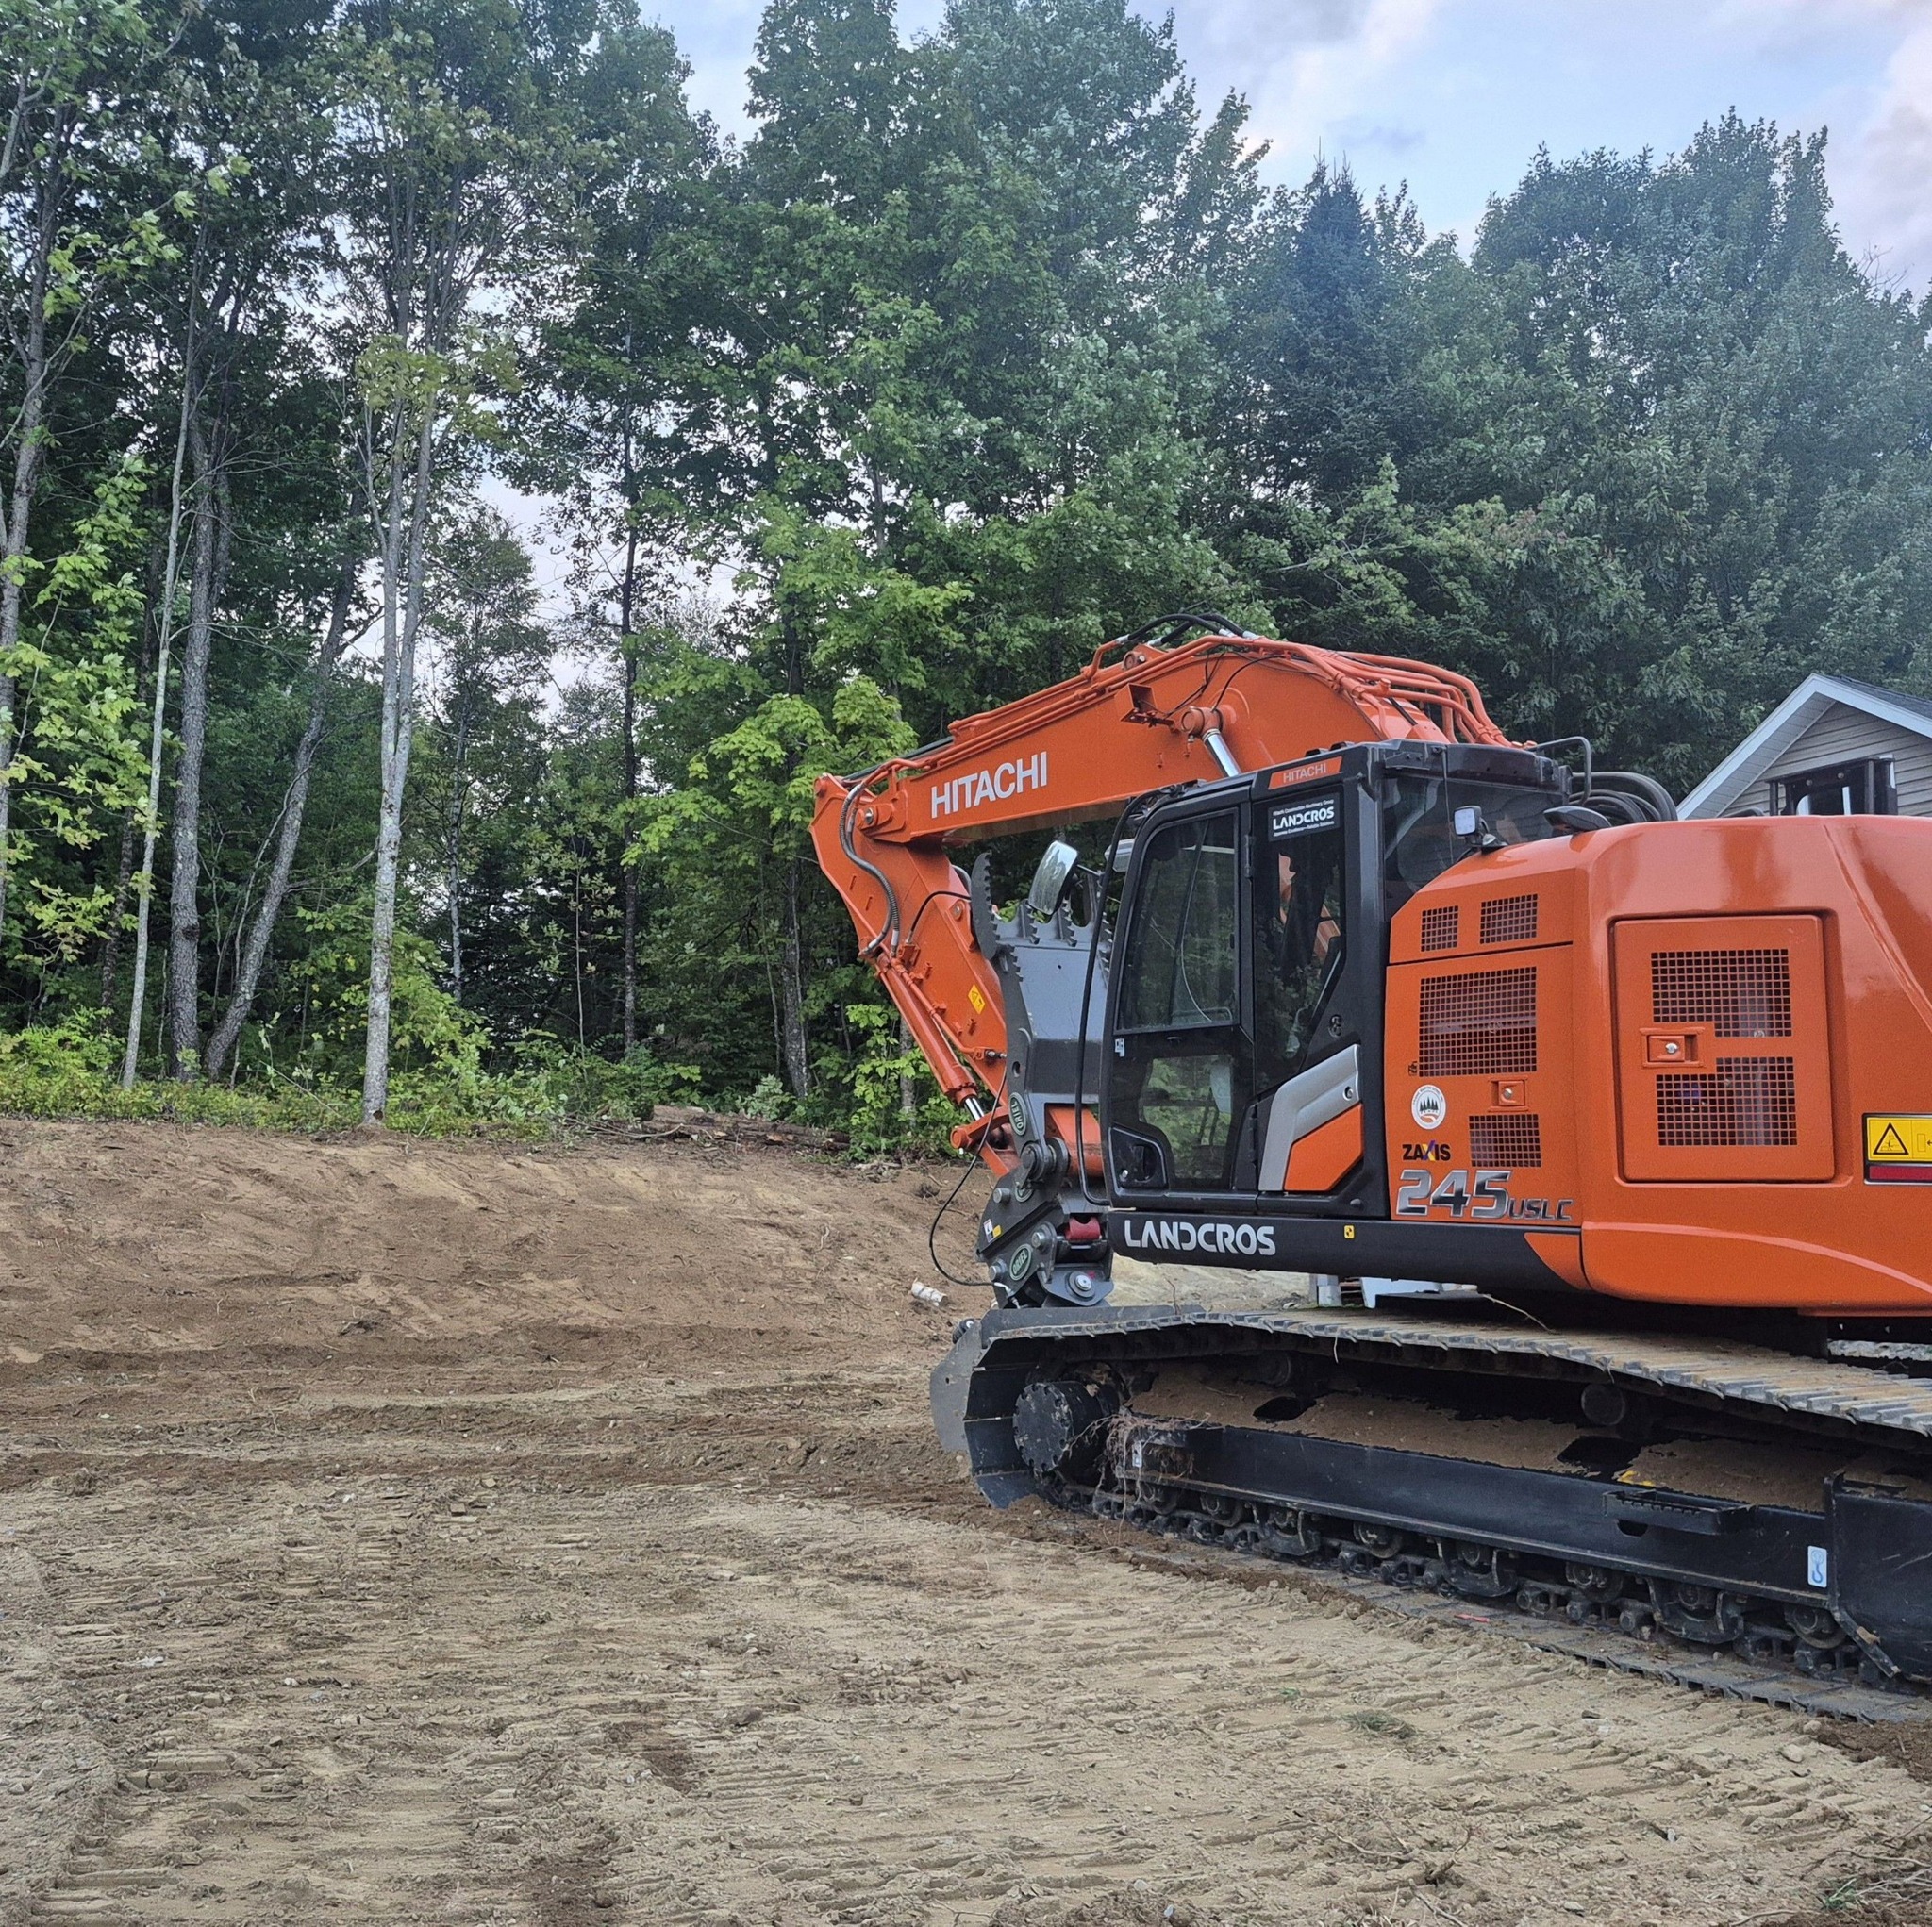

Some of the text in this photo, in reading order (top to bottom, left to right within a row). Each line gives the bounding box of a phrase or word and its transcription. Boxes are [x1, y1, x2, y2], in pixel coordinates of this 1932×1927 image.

[931, 751, 1047, 819] HITACHI
[1284, 763, 1326, 783] HITACHI
[1273, 806, 1335, 830] LANDCROS
[1011, 1102, 1024, 1131] ORIEL
[1402, 1140, 1451, 1161] ZAXIS
[1124, 1220, 1276, 1256] LANDCROS
[1012, 1250, 1028, 1274] ORIEL
